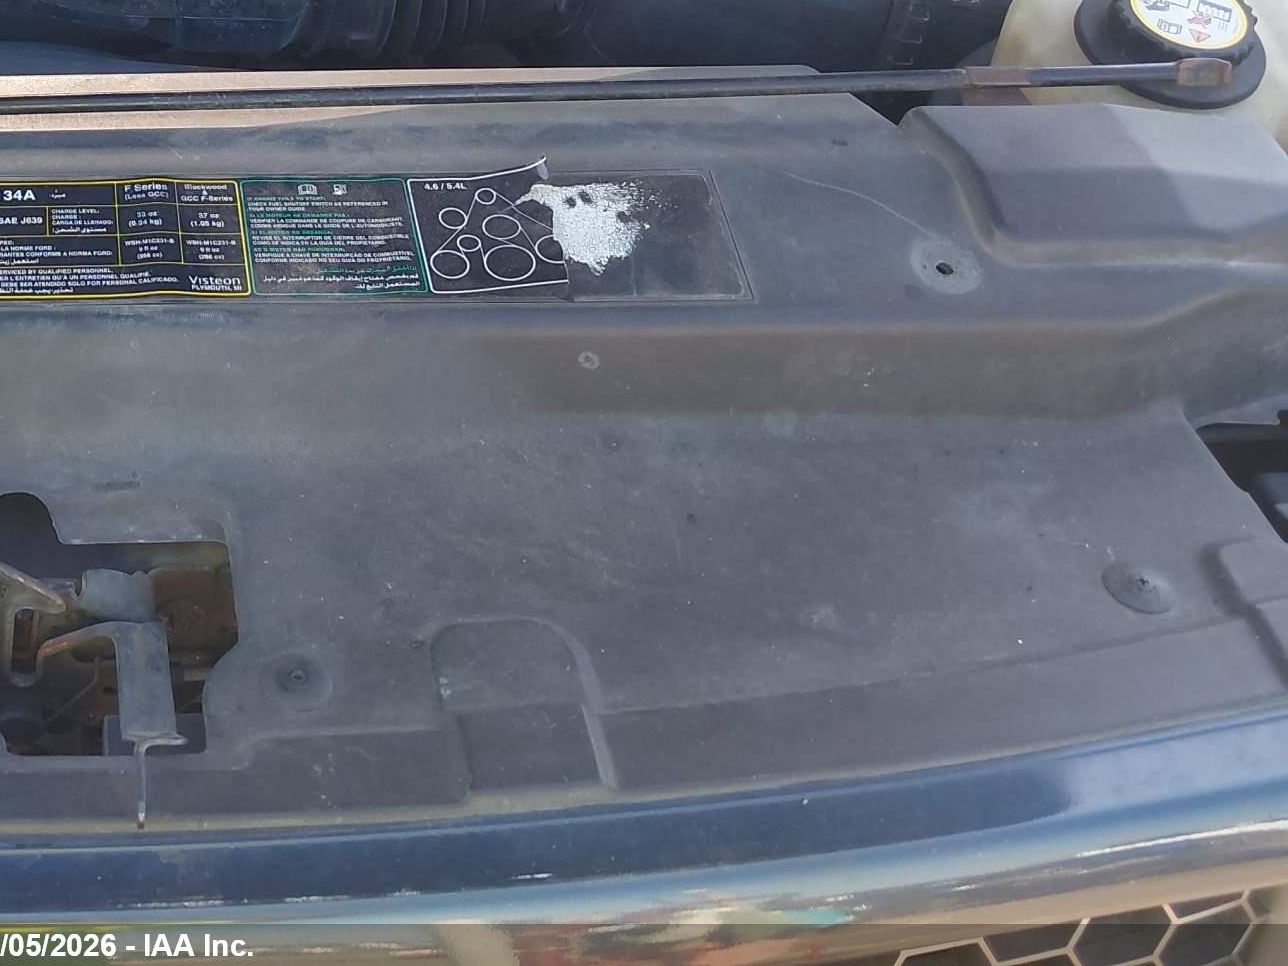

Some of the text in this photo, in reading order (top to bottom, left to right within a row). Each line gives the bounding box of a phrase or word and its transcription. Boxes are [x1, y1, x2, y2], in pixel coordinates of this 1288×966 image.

[124, 182, 168, 192] F Series
[424, 183, 439, 191] 4.6
[446, 182, 467, 190] 5.4L
[20, 216, 44, 225] J639
[211, 220, 225, 228] kg)
[138, 276, 179, 284] CALIFICADO.
[188, 275, 241, 285] Visteon
